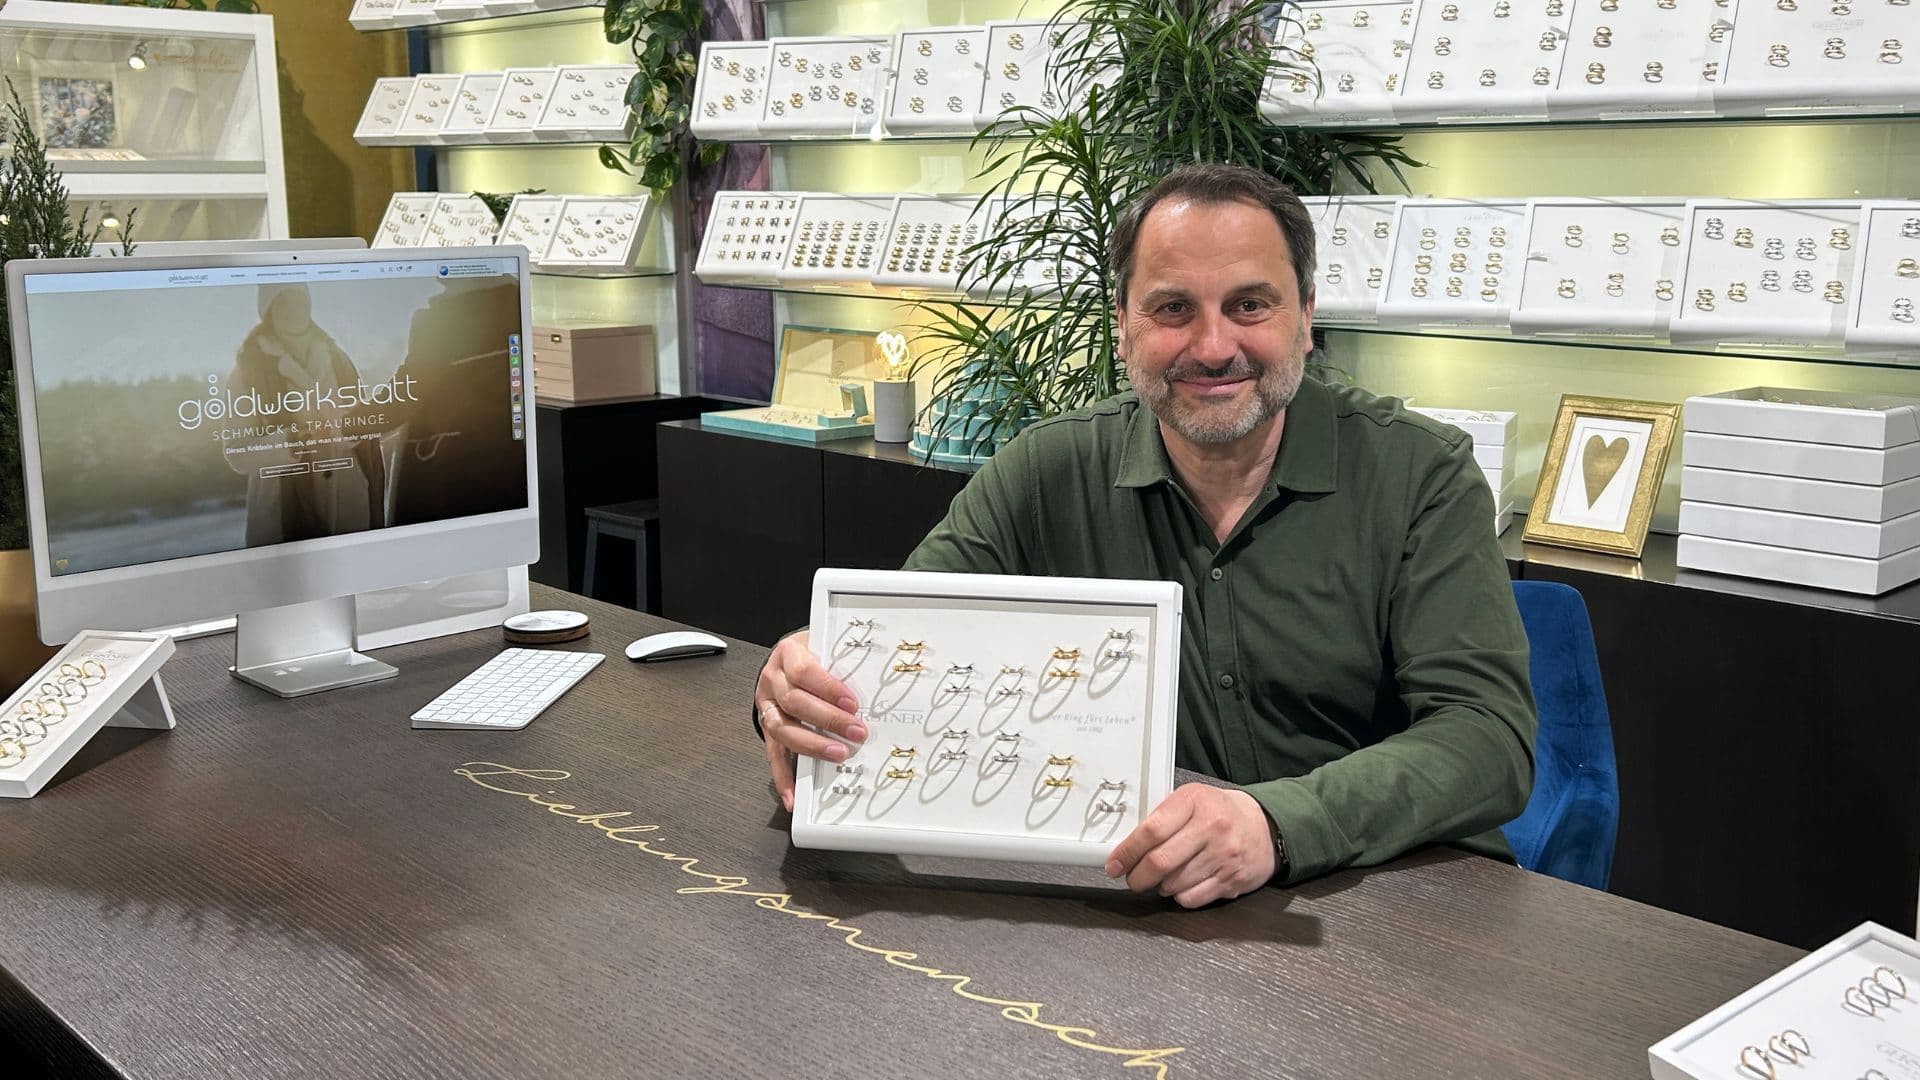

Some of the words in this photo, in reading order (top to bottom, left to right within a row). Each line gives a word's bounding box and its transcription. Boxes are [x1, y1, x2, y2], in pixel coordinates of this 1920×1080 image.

[212, 424, 285, 441] SCHMUCK
[290, 422, 299, 433] &
[306, 414, 390, 432] TRAURINGE.
